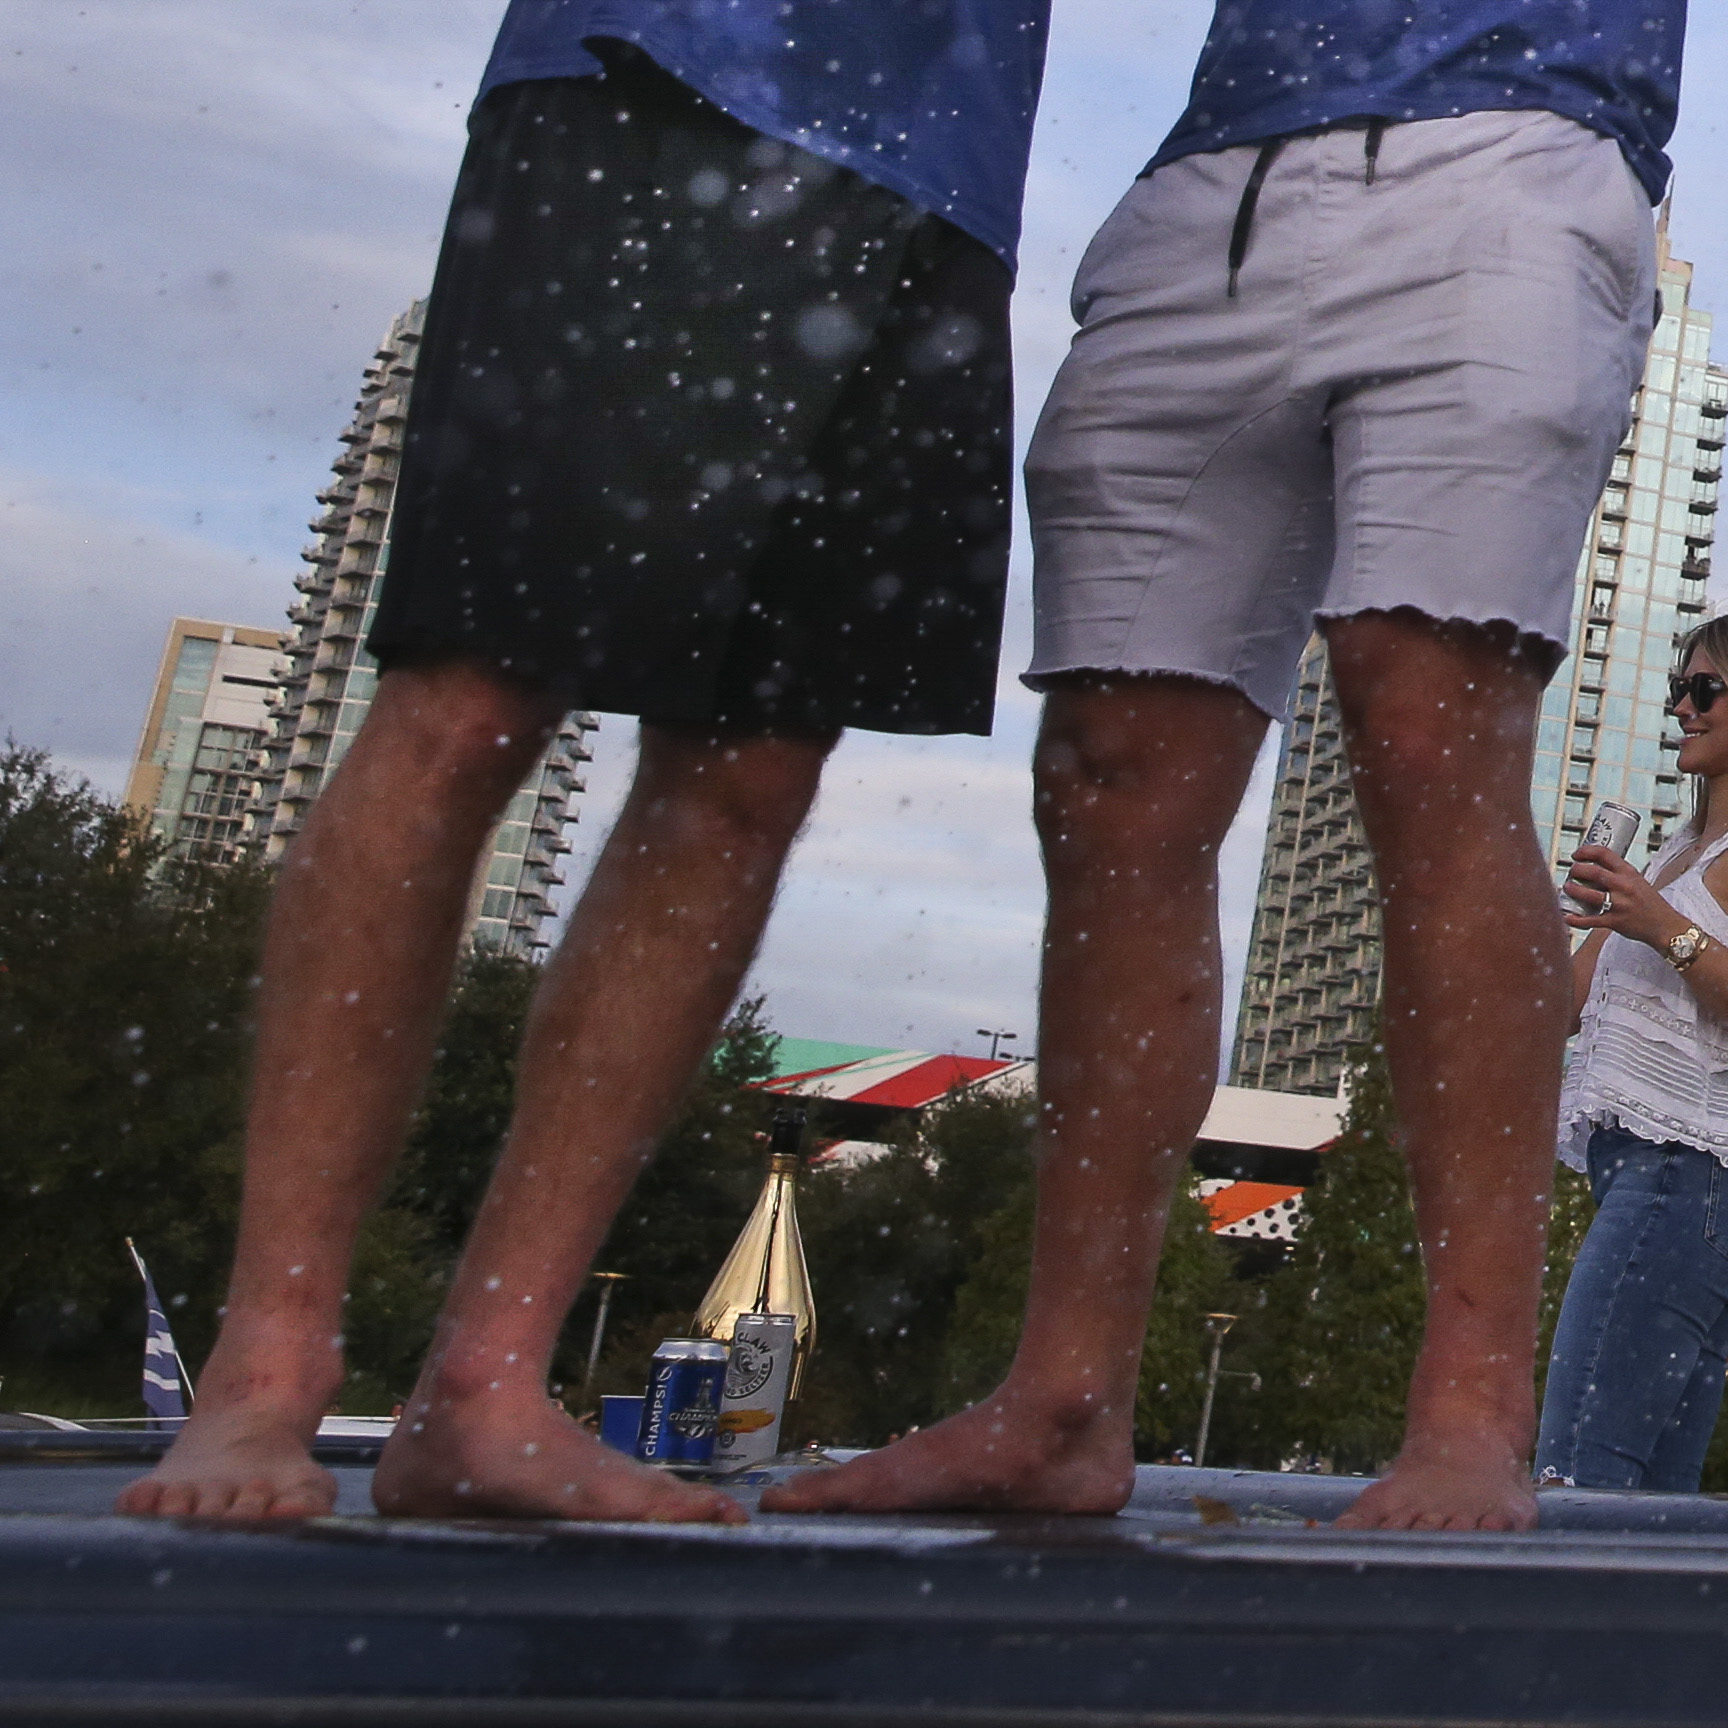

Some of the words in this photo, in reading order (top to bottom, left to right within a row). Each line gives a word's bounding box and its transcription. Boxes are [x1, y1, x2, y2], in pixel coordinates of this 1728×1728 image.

[737, 1332, 771, 1354] CLAW
[739, 1363, 769, 1394] SELTZER
[645, 1384, 668, 1456] CHAMPSI
